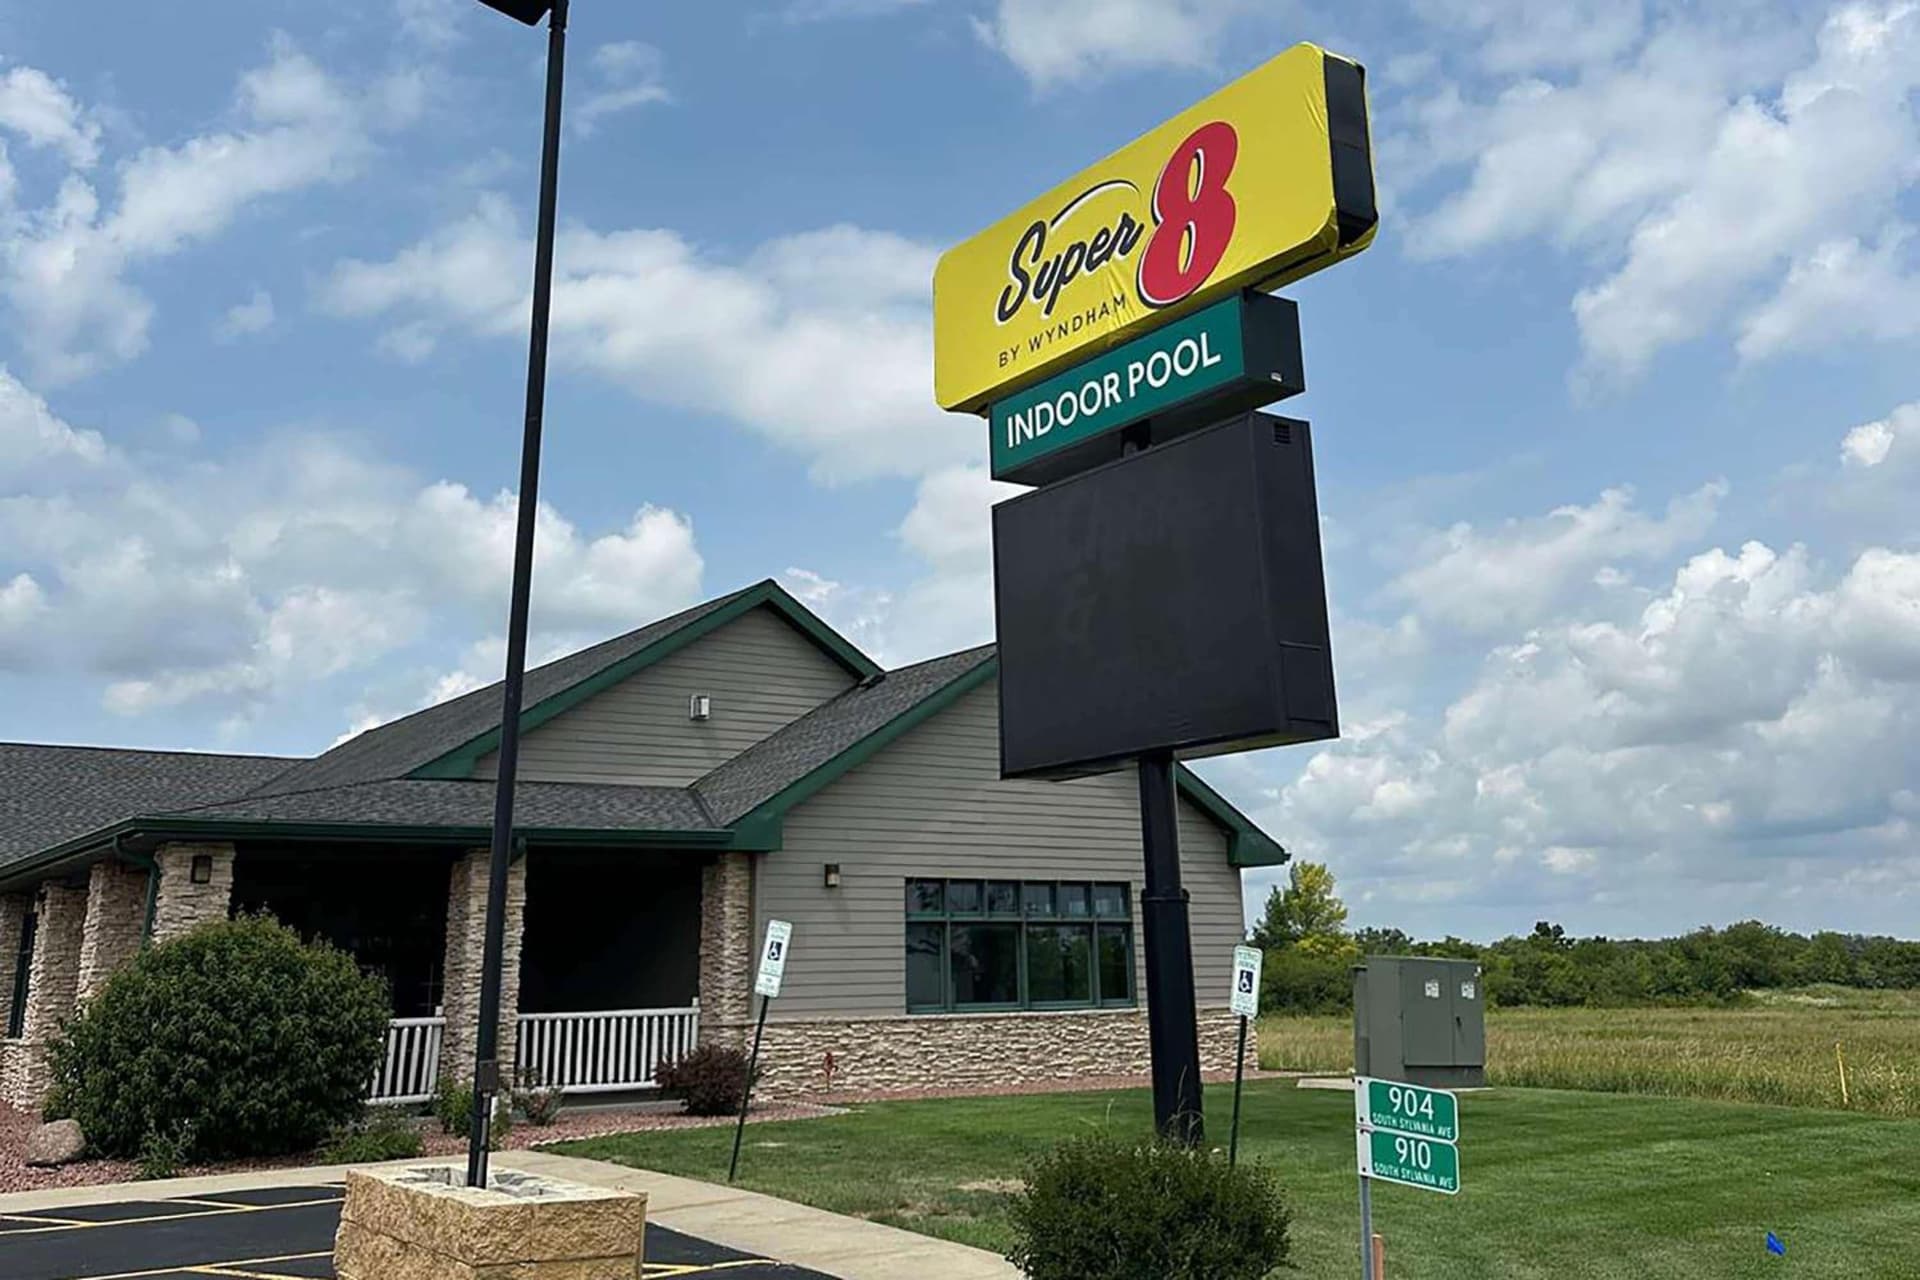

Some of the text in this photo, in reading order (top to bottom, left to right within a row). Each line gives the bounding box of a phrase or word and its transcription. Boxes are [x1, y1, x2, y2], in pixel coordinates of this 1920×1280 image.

[996, 121, 1238, 324] Super 8
[998, 294, 1126, 368] BY WYNDHAM
[1007, 332, 1221, 448] INDOOR POOL
[1389, 1086, 1434, 1120] 904
[1372, 1112, 1453, 1139] SOUTH SYLVANIA AVE
[1395, 1137, 1431, 1170] 910
[1374, 1162, 1454, 1189] SOUTH SYLVANIA AVE
